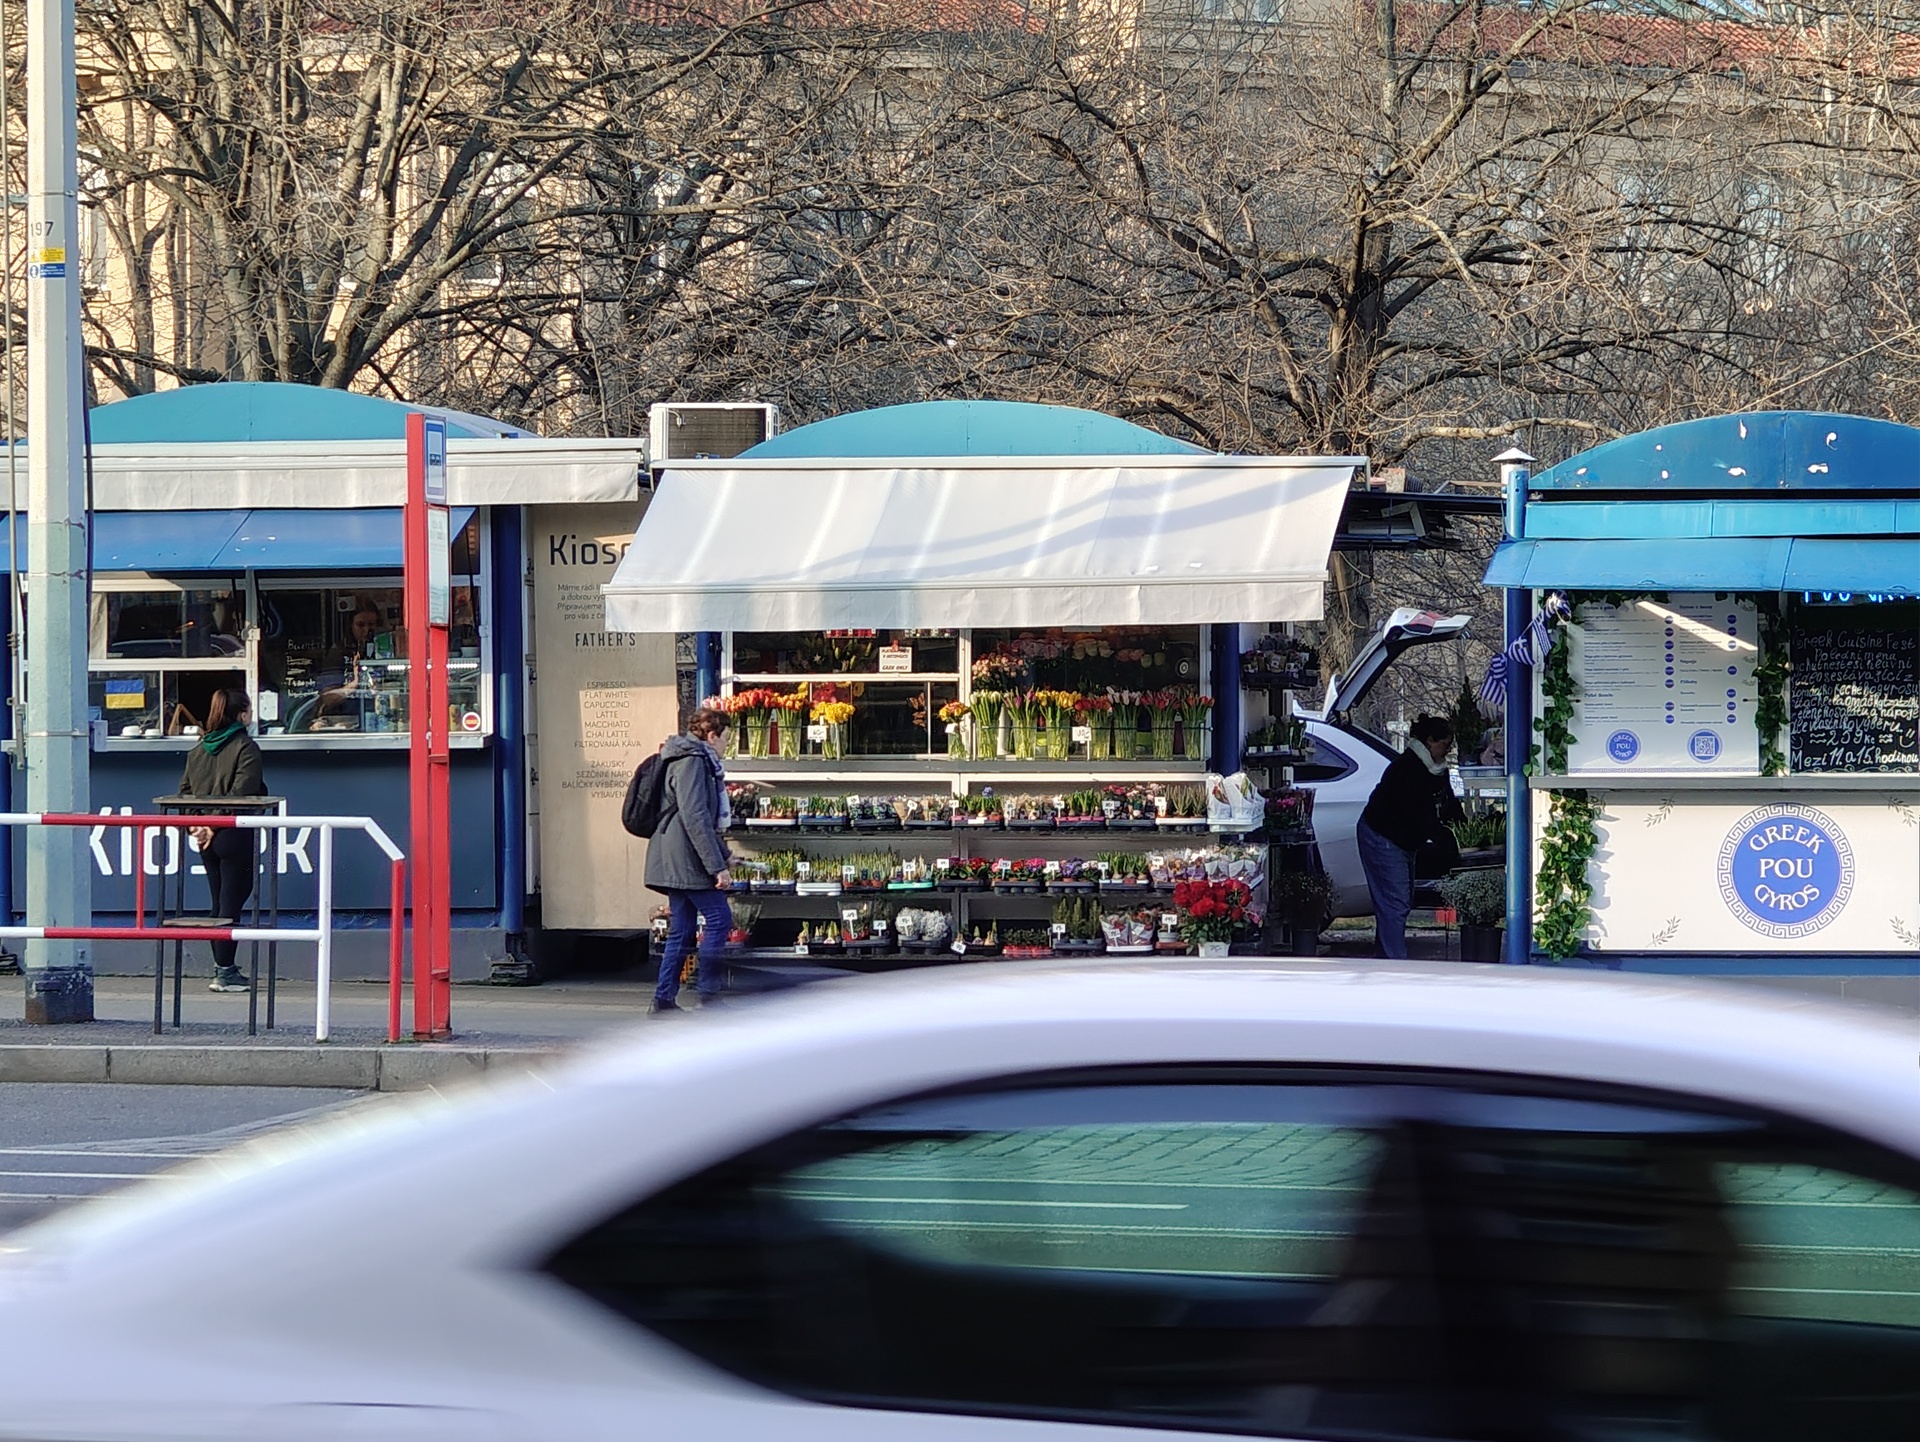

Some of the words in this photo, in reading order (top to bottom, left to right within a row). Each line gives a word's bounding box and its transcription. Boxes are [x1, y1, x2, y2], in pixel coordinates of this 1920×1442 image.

[31, 221, 54, 236] 197
[575, 632, 636, 647] FATHER'S
[1886, 632, 1916, 650] Fest
[586, 681, 626, 689] ESPRESSO
[585, 691, 603, 699] FLAT
[604, 691, 628, 699] WHITE
[584, 701, 630, 709] CAPUCCINO
[595, 711, 618, 719] LATTE
[584, 721, 630, 729] MACCHIATO
[1790, 750, 1828, 770] Mezi
[1749, 824, 1826, 855] GREEK
[1759, 858, 1814, 879] POU
[1754, 883, 1821, 911] GYROS
